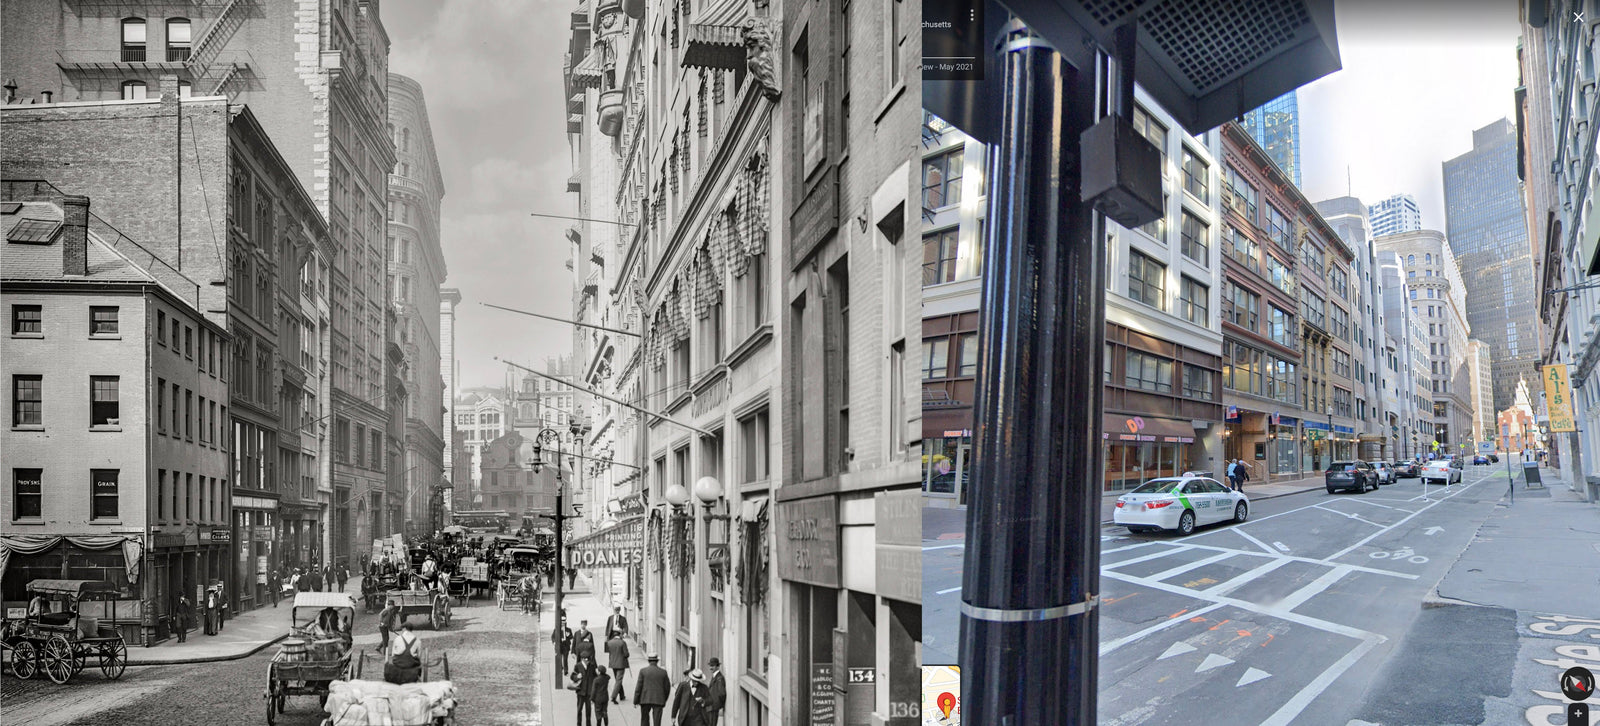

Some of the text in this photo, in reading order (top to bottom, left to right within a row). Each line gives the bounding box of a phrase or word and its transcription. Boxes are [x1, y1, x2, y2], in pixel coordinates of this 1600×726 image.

[605, 533, 641, 541] PRINTING
[848, 670, 875, 683] 134
[888, 701, 920, 719] 136
